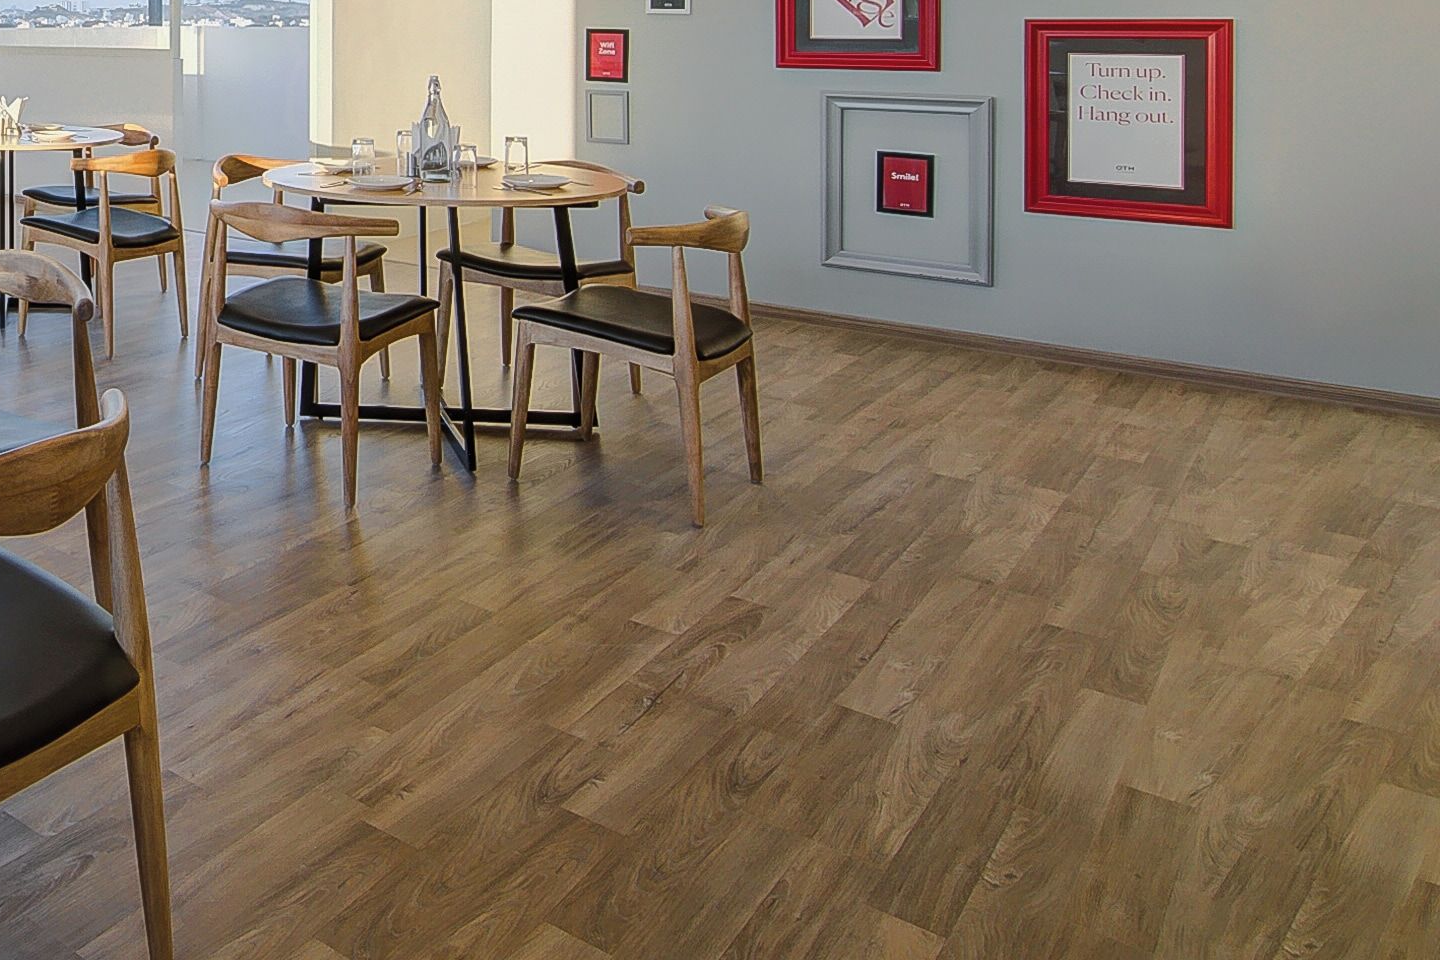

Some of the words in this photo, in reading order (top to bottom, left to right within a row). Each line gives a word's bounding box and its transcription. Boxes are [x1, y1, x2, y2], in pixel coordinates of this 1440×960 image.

[1085, 62, 1130, 78] Turn
[1136, 68, 1166, 82] up.
[1080, 84, 1144, 101] Check
[1149, 87, 1172, 102] in.
[1078, 105, 1131, 125] Hang
[1135, 113, 1174, 124] out.
[891, 171, 920, 181] Smile!
